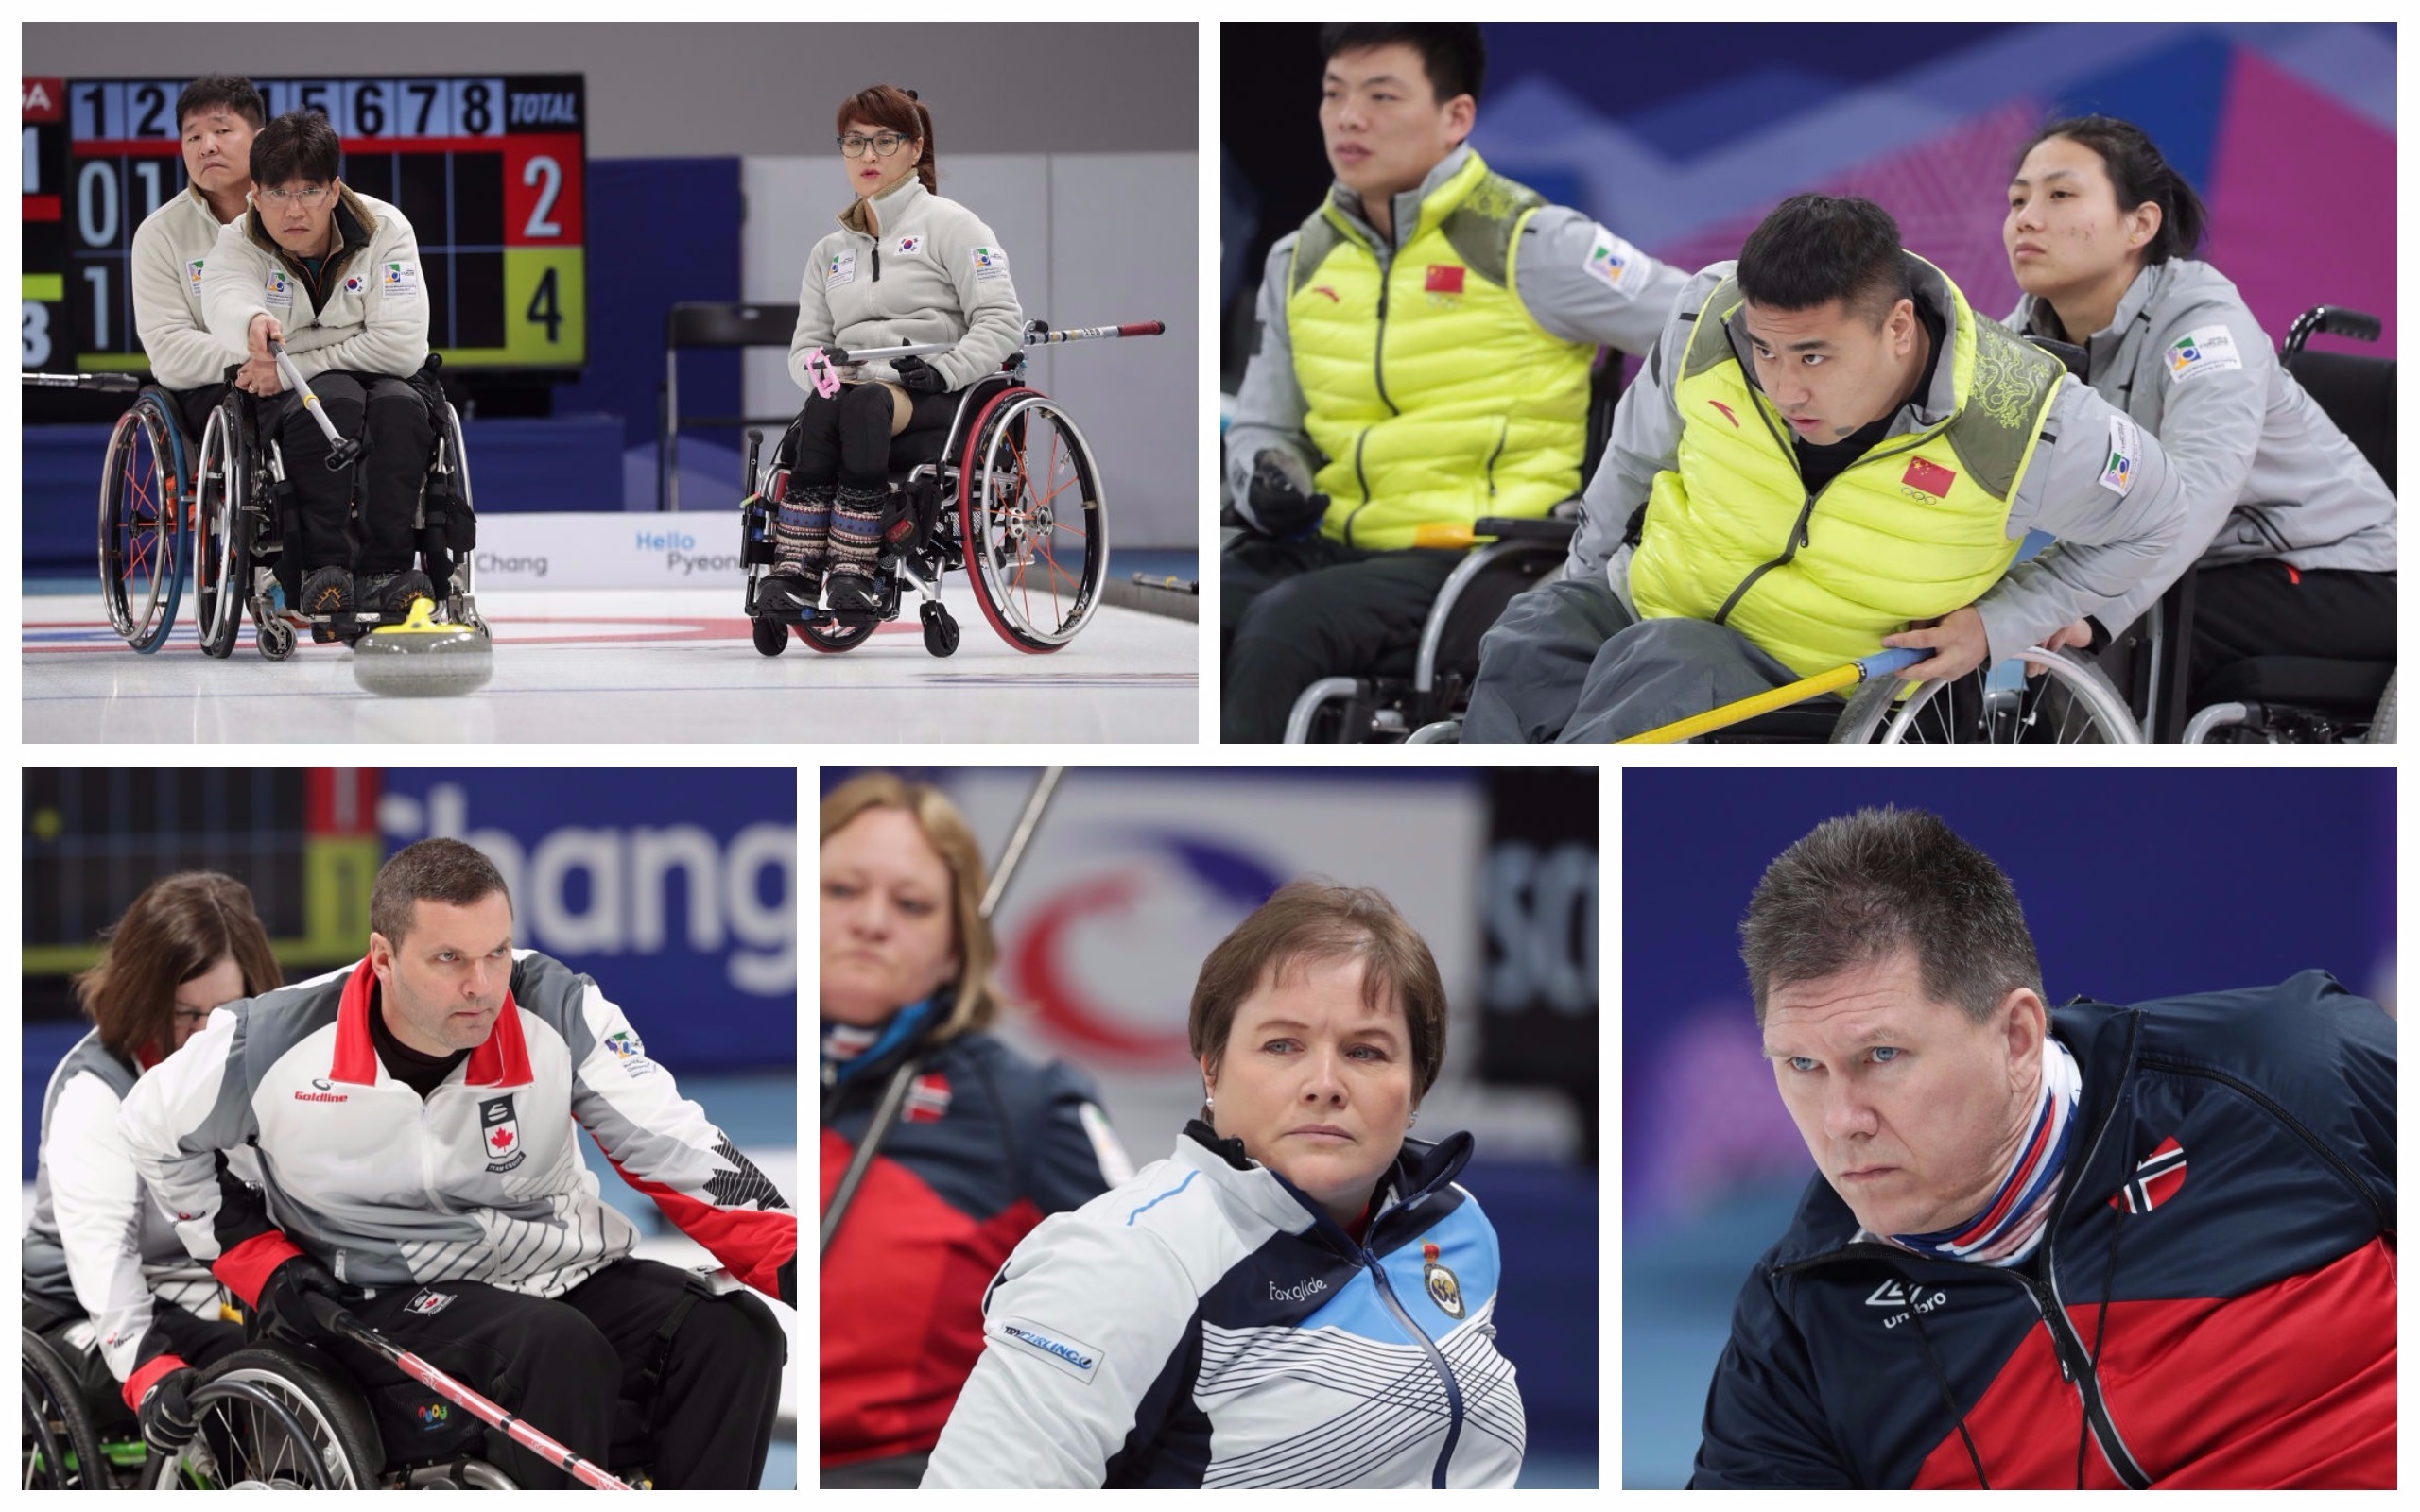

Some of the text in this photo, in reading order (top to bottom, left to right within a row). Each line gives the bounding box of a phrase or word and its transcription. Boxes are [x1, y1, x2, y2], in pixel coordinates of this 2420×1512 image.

[135, 84, 166, 136] 2
[353, 84, 385, 137] 6
[406, 85, 439, 134] 7
[462, 82, 492, 135] 8
[510, 93, 579, 125] TOTAL
[523, 155, 562, 237] 2
[526, 266, 563, 345] 4
[635, 530, 696, 550] Hello
[475, 553, 549, 577] Chang
[294, 1091, 348, 1103] Goldline
[1269, 1277, 1327, 1301] Foxglide
